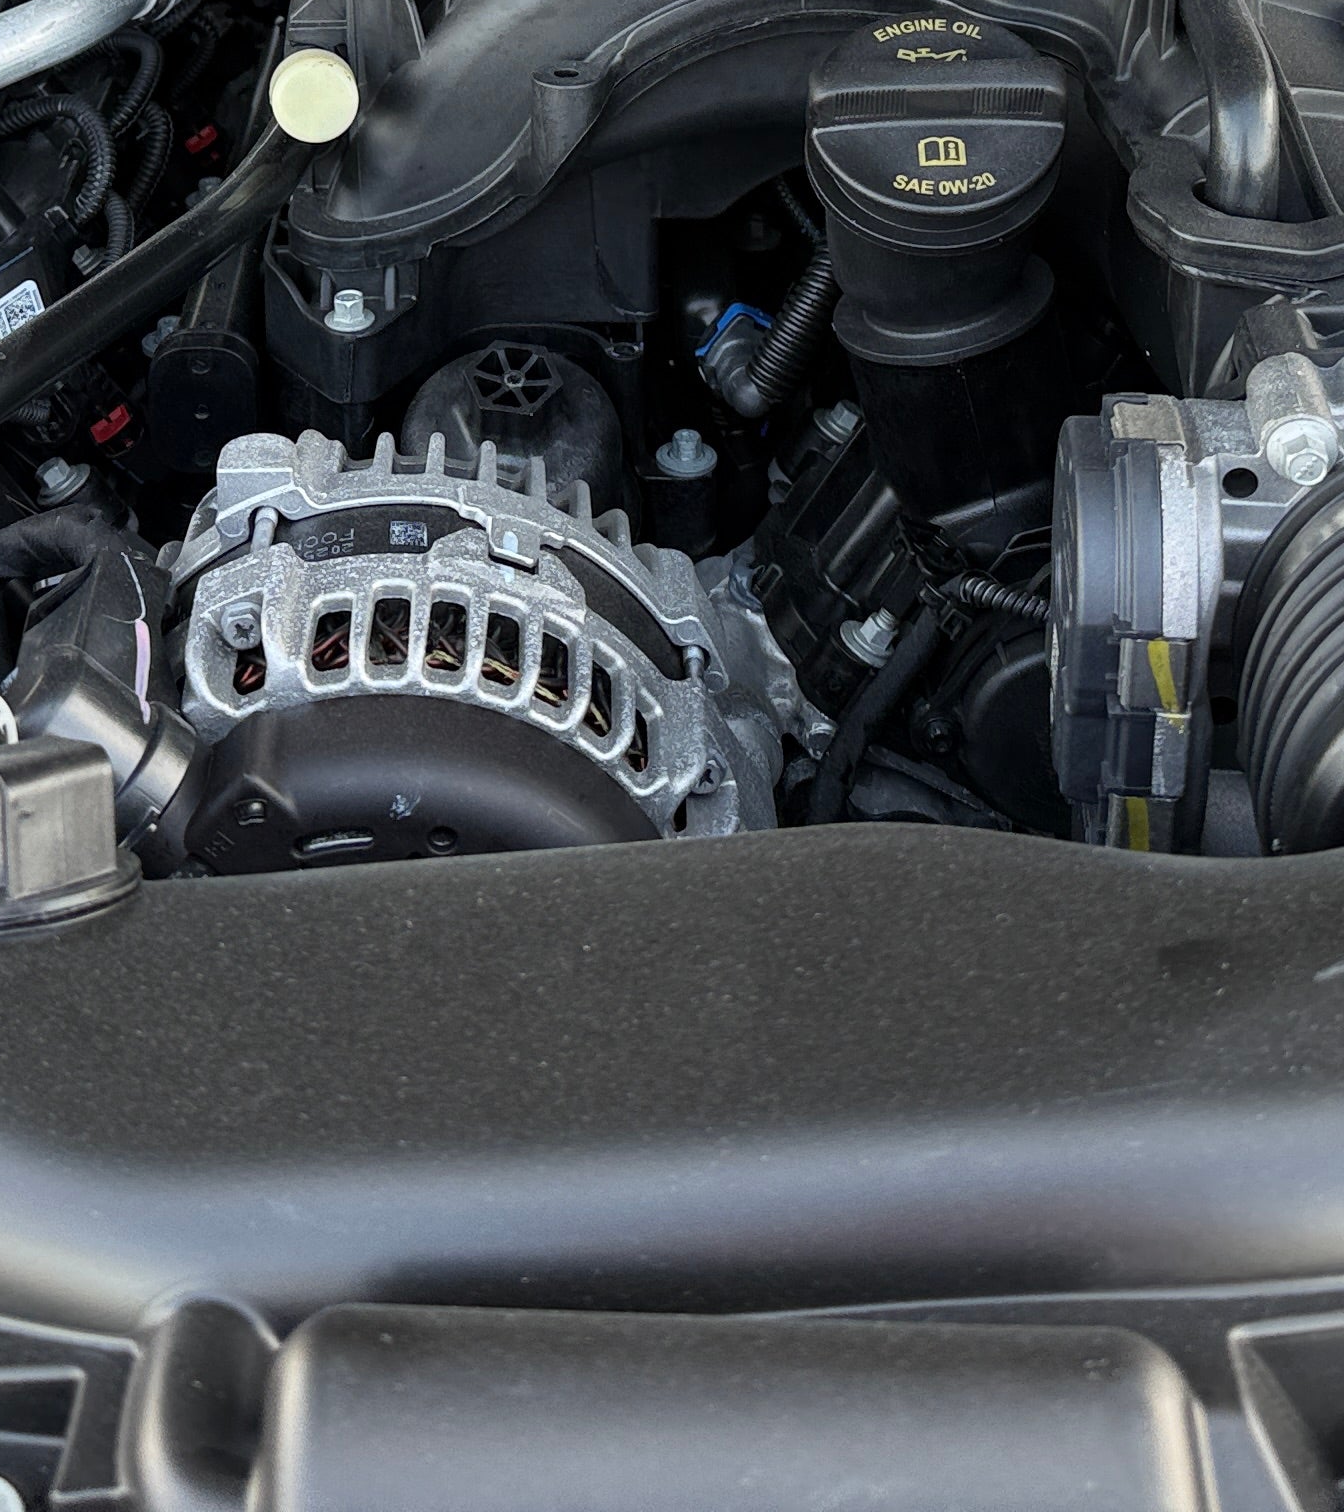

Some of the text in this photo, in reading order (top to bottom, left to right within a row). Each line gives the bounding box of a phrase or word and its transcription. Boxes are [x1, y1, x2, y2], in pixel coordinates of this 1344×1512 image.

[873, 18, 982, 43] ENGINE OIL
[893, 172, 997, 196] SAE 0W-20
